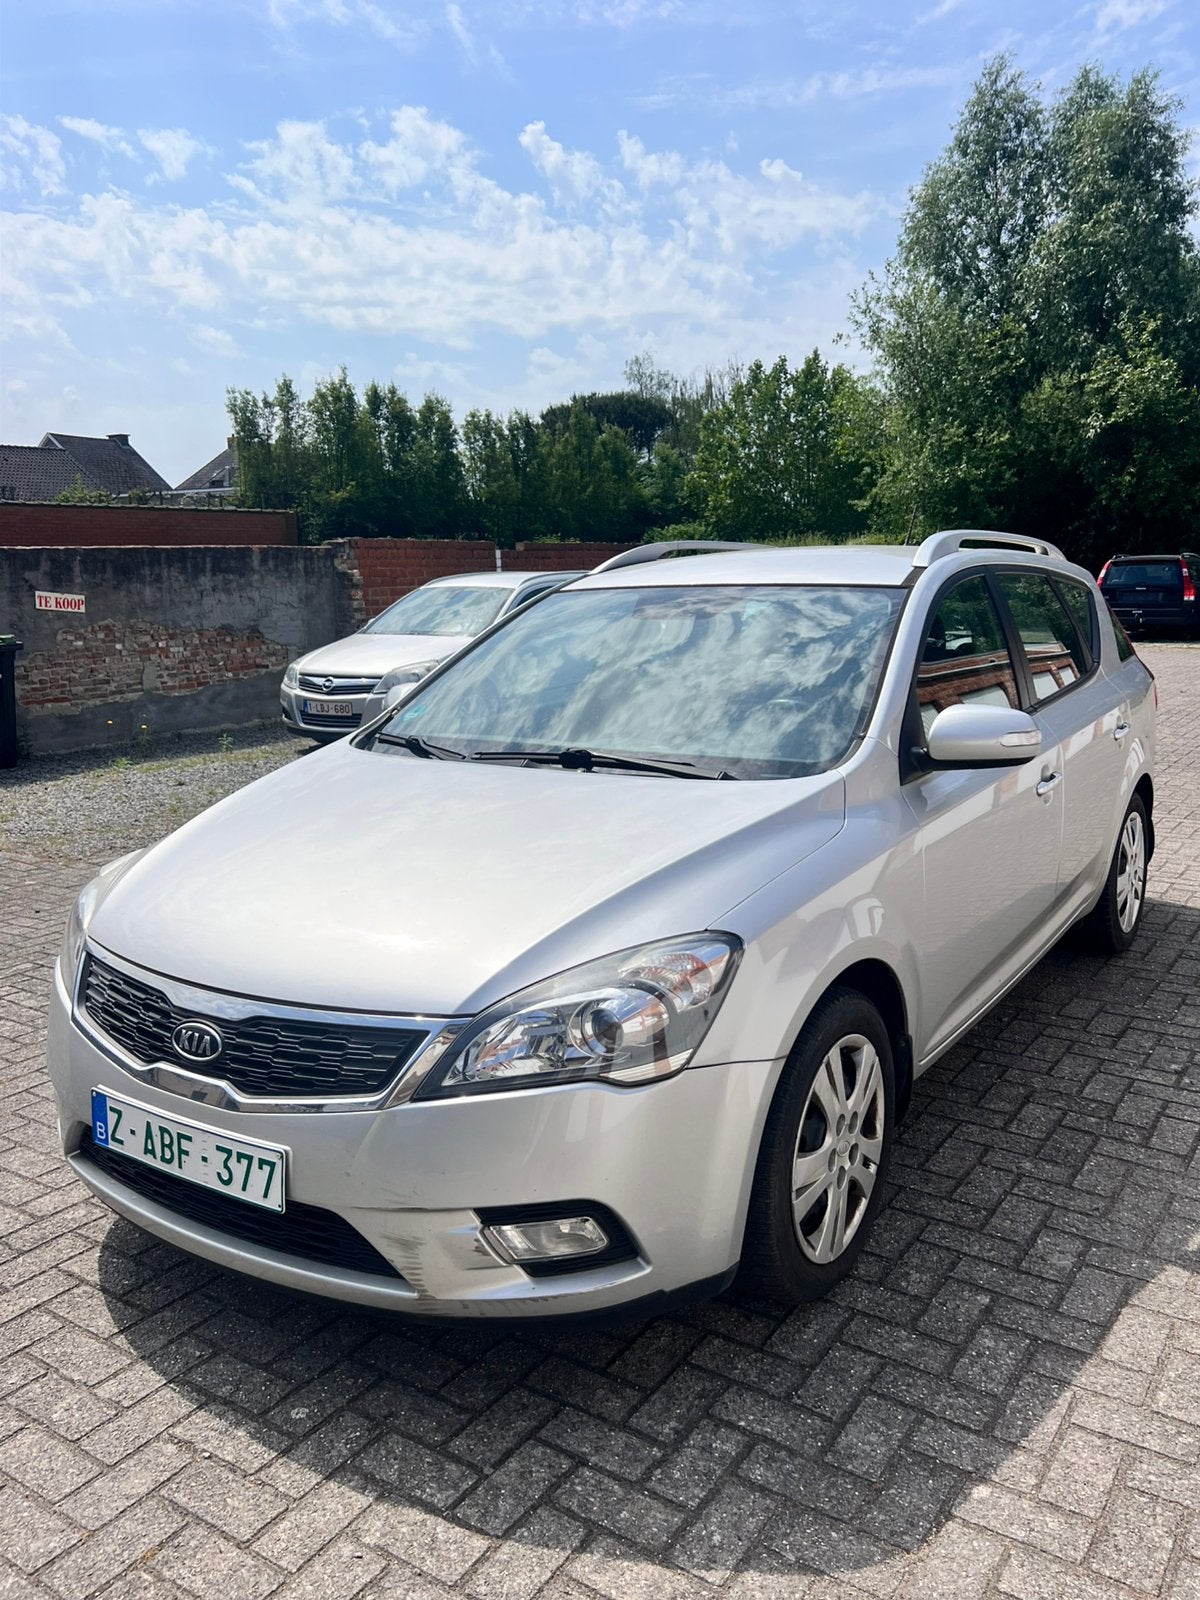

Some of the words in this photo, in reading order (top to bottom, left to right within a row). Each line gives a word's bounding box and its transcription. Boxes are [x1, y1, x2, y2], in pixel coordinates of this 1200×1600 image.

[37, 595, 52, 608] TE
[55, 596, 85, 610] KOOP
[179, 1029, 211, 1056] KIA
[96, 1121, 106, 1139] B
[109, 1104, 276, 1198] Z-ABF-377
